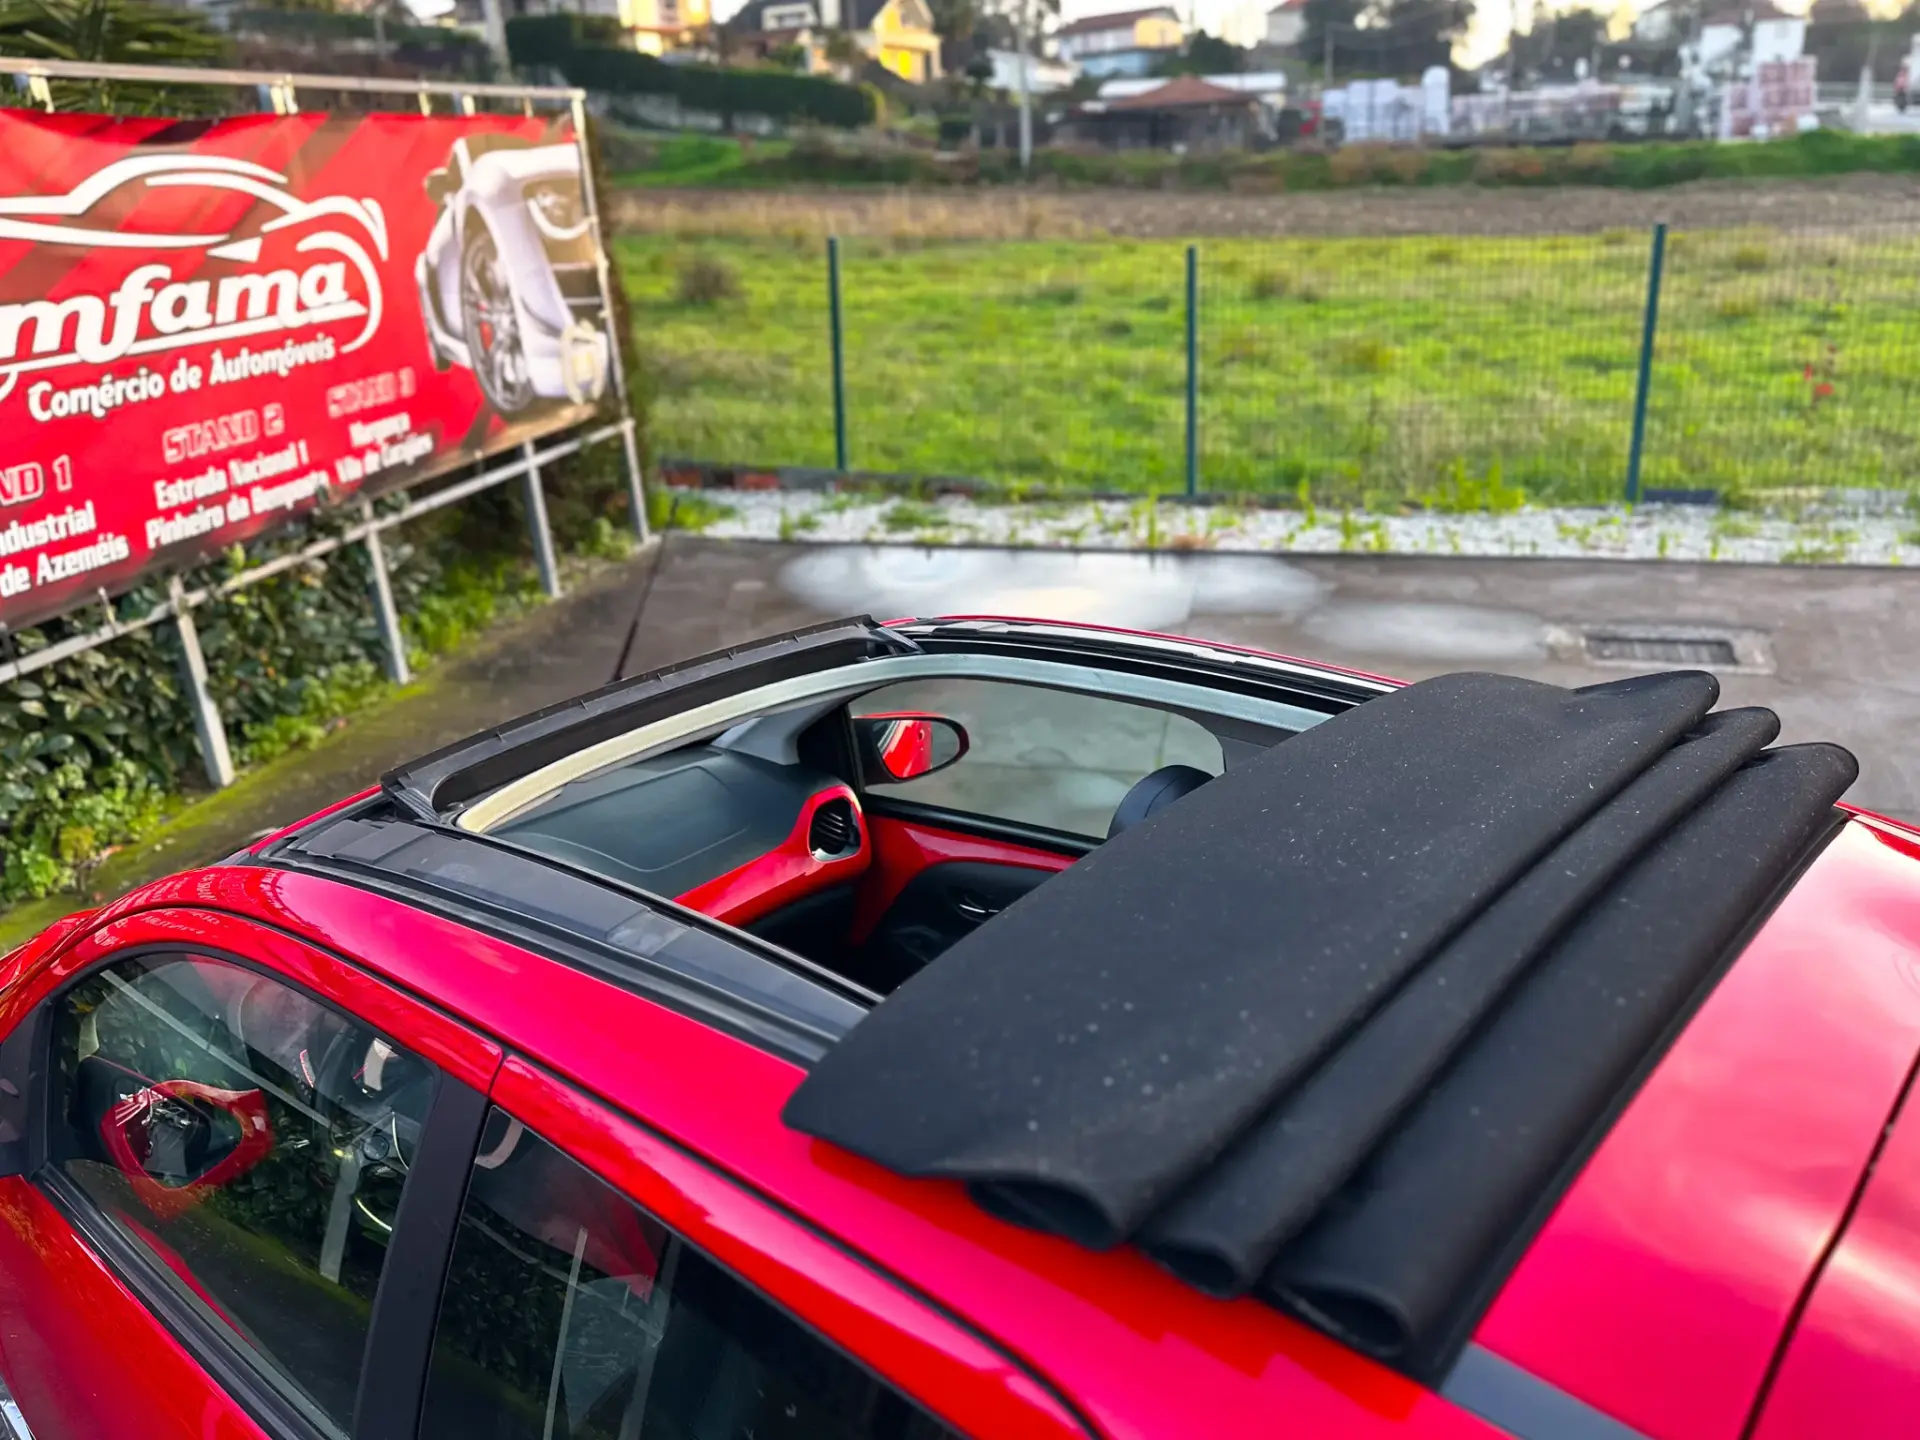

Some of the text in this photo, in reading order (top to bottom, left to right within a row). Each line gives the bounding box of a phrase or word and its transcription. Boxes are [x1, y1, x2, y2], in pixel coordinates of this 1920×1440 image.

[27, 333, 336, 422] Comércio de Automóveis
[162, 402, 285, 465] STAND 2
[52, 453, 73, 493] 1
[154, 465, 228, 511] Estrada
[145, 504, 225, 550] Pinheiro
[226, 493, 251, 523] da
[0, 532, 130, 598] de Azeméis
